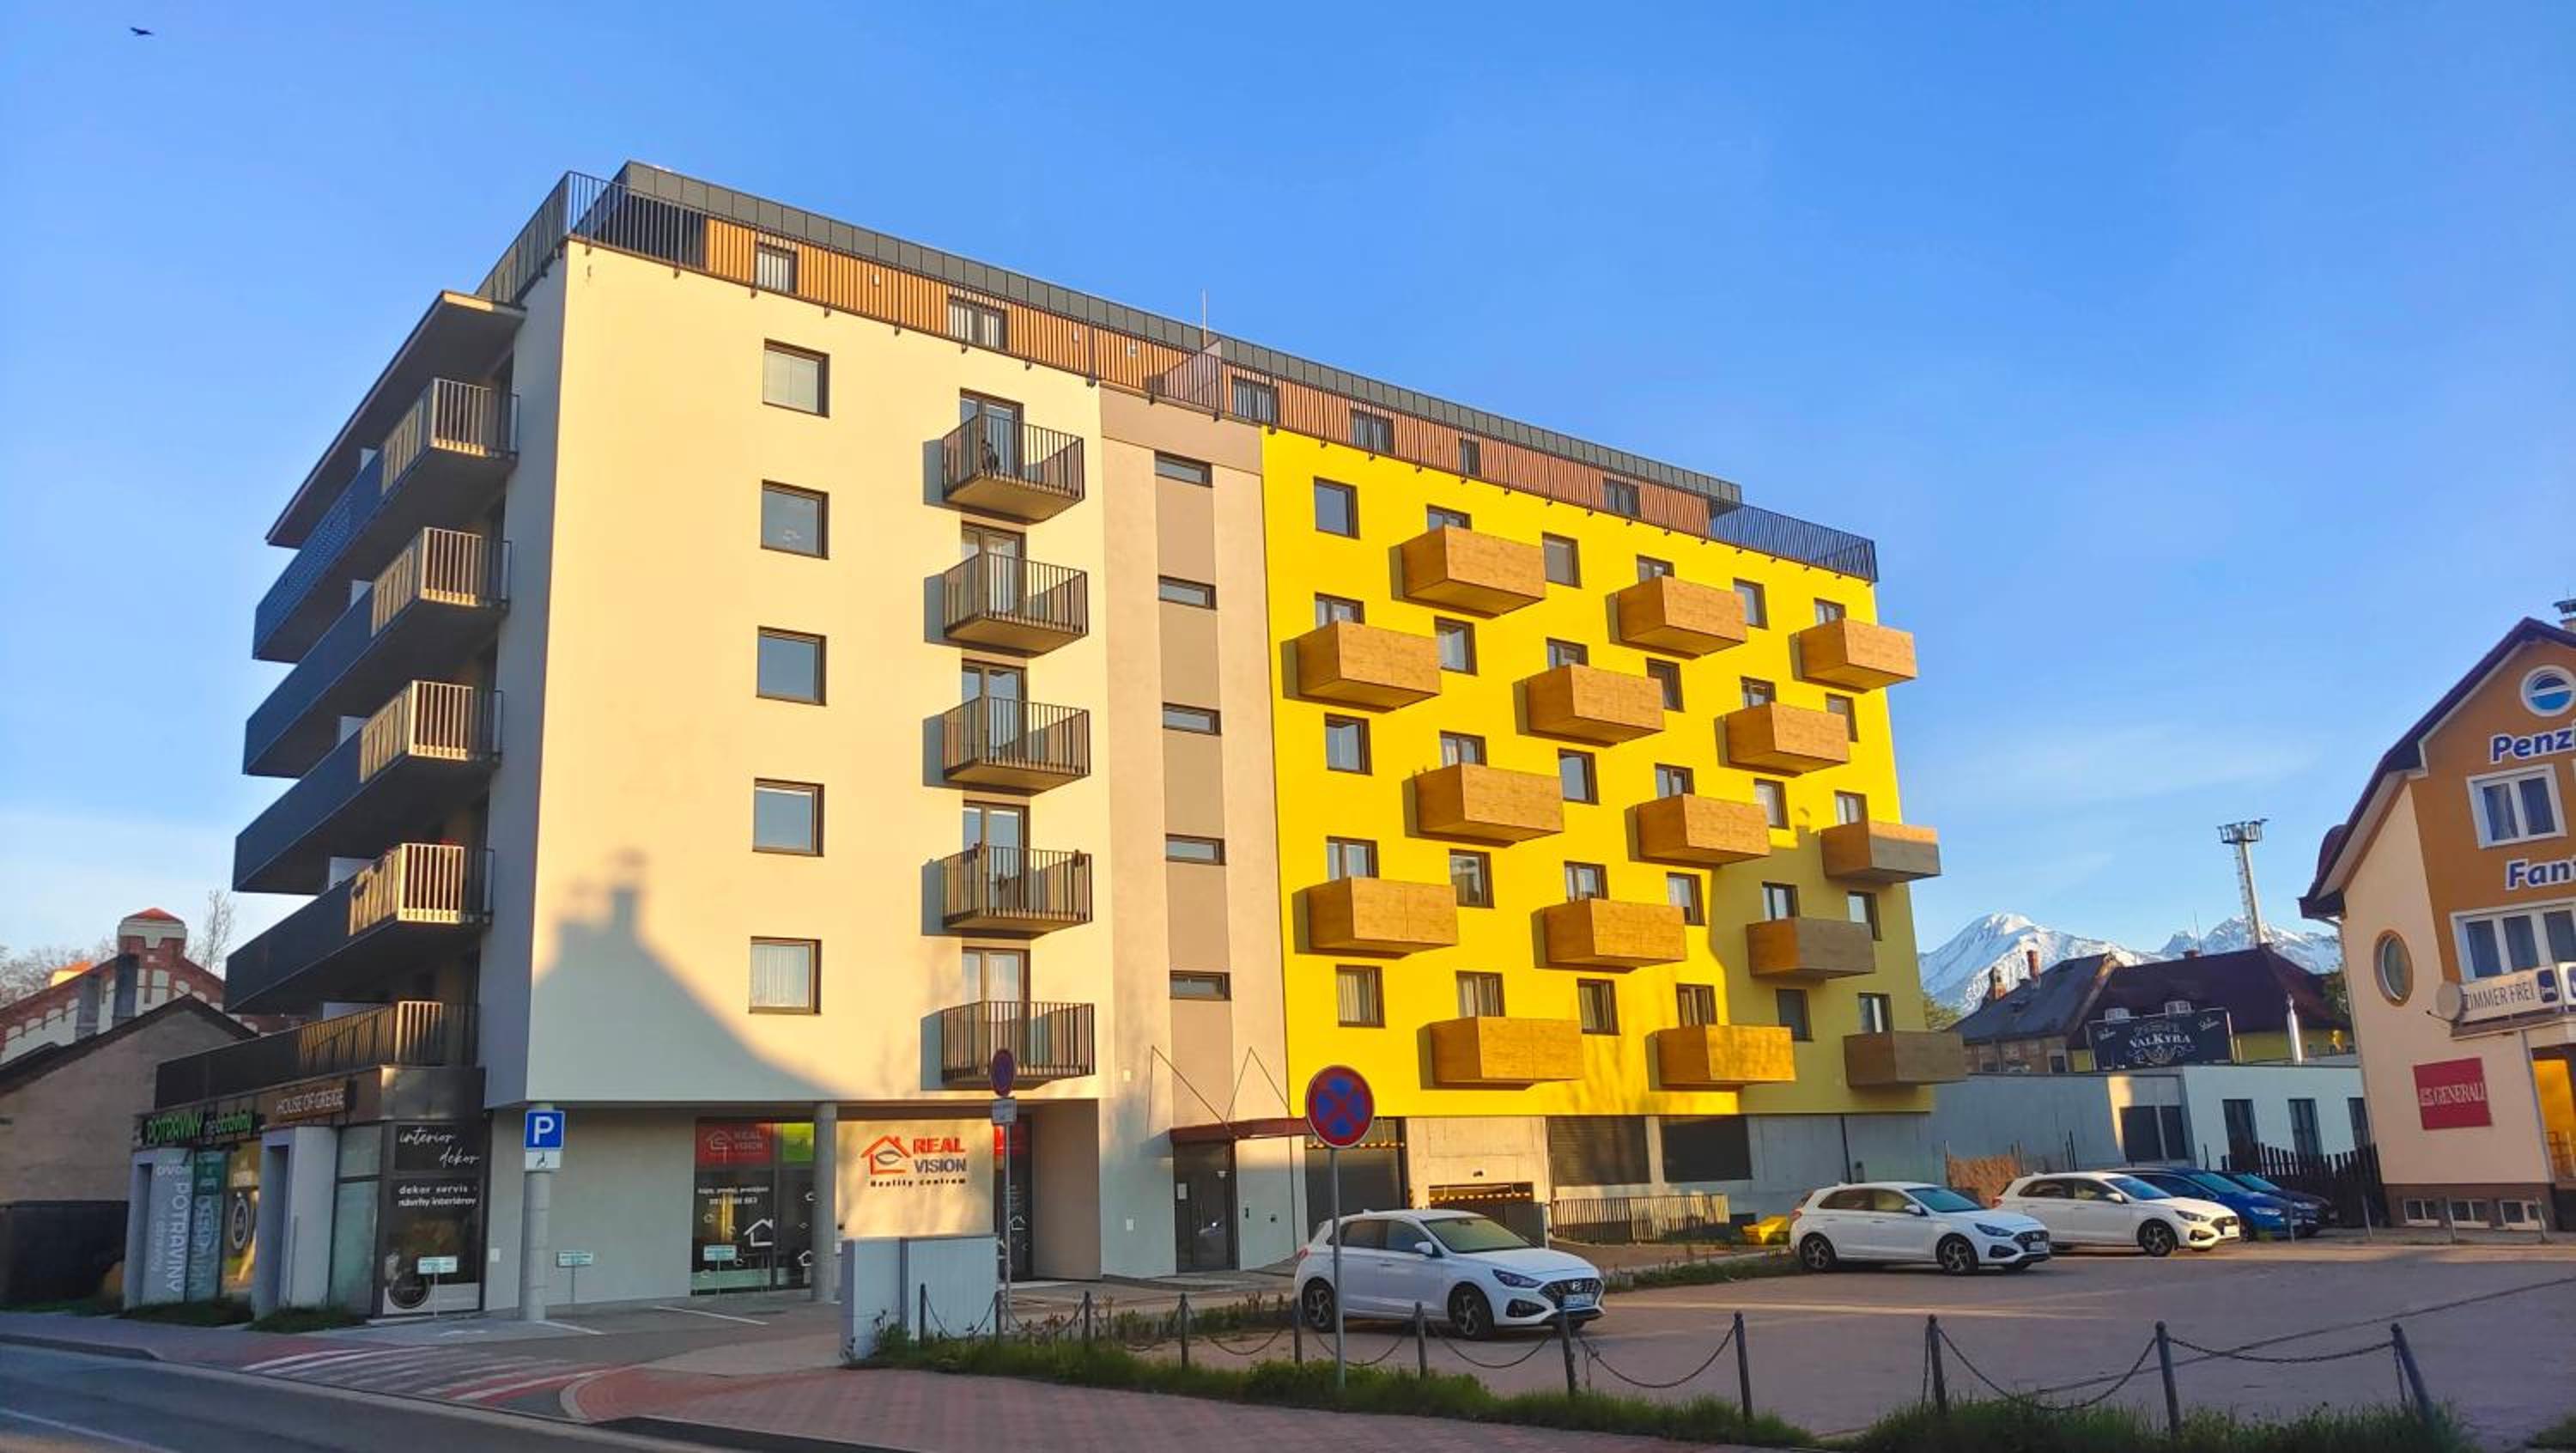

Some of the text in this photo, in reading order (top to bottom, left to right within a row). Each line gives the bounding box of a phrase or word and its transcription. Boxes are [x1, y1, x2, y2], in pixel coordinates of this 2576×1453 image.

[2492, 726, 2576, 763] Penz
[2506, 857, 2576, 891] Fan
[2509, 982, 2536, 1003] FREI
[147, 1112, 204, 1144] POTRAVINY
[399, 1127, 455, 1146] interior
[533, 1116, 555, 1145] P
[439, 1145, 480, 1169] dekor
[913, 1137, 966, 1154] REAL
[914, 1158, 967, 1174] VISION
[166, 1182, 191, 1292] POTRAVINY
